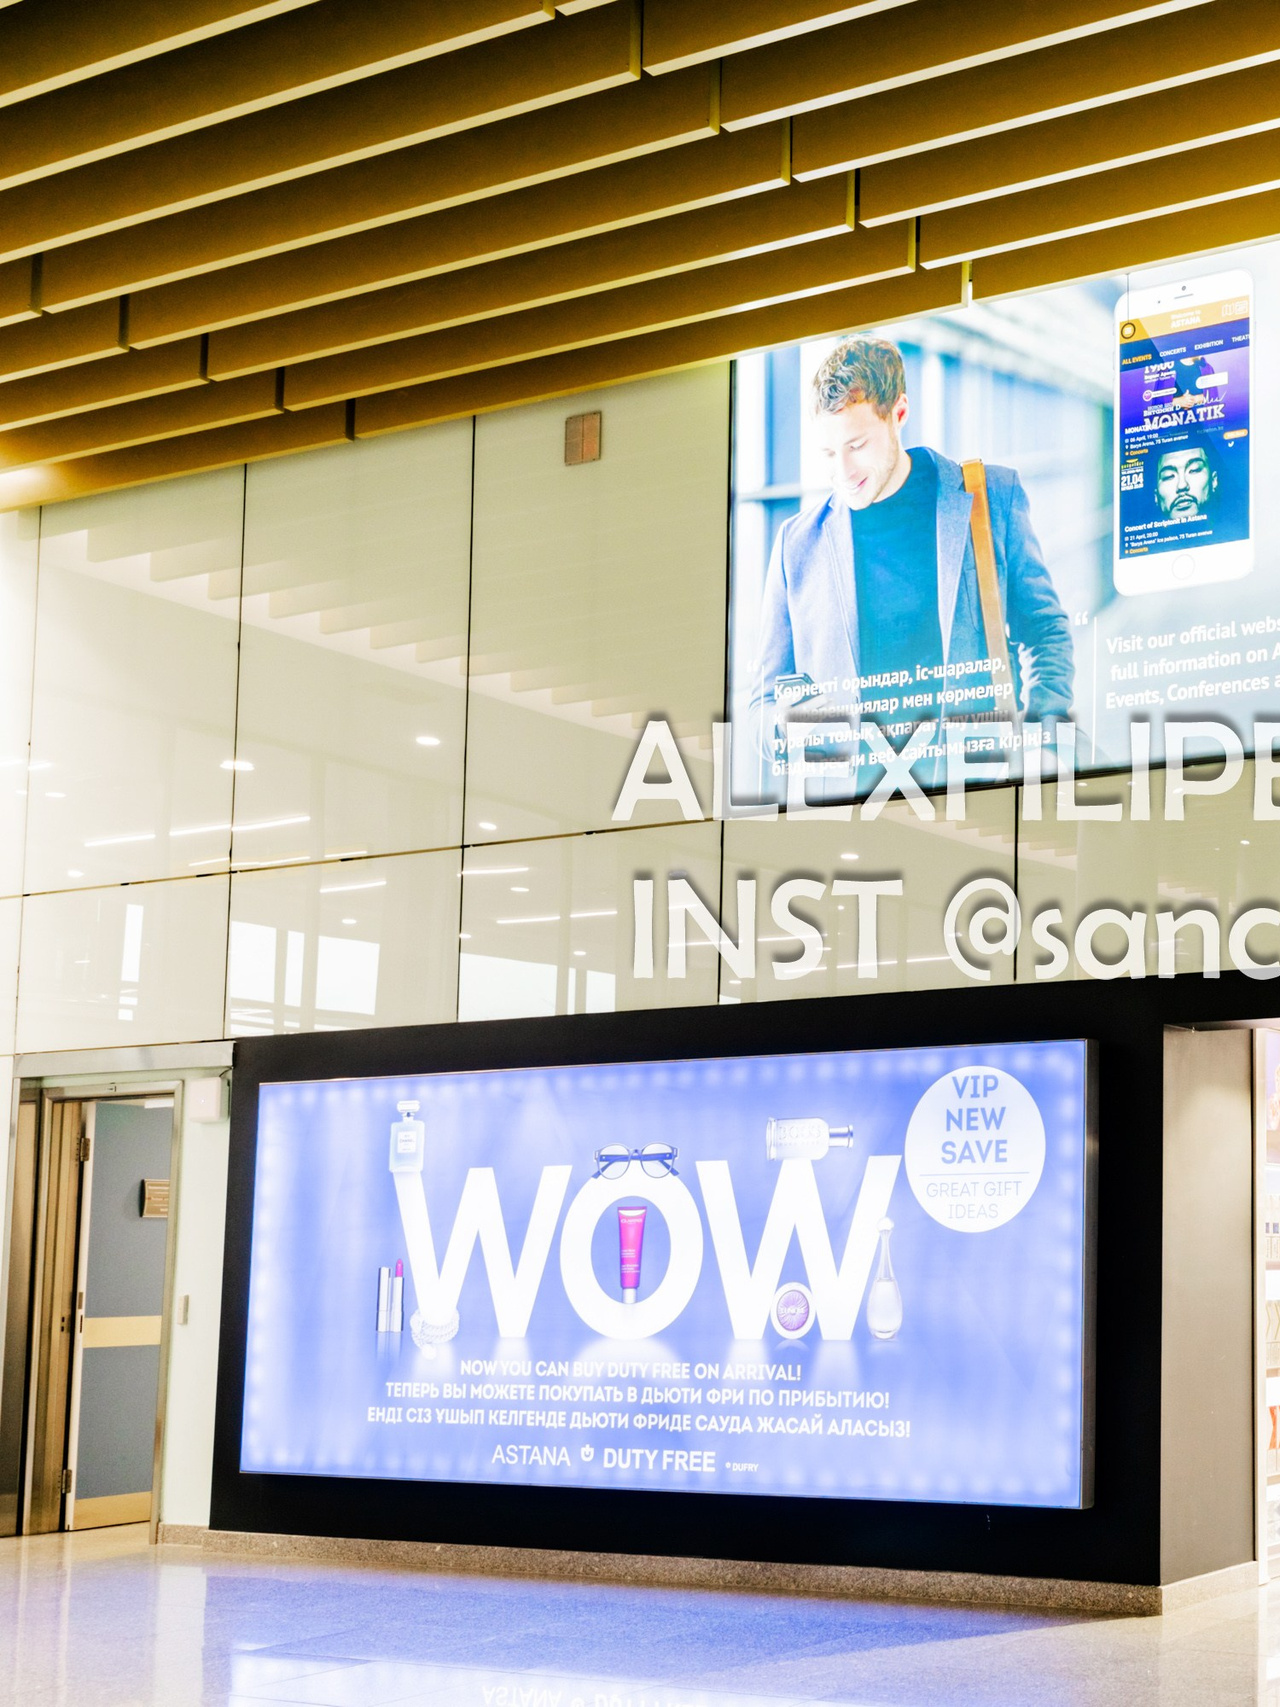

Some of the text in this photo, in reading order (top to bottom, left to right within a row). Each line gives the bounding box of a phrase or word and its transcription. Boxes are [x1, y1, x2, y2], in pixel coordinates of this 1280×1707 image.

[1132, 353, 1152, 363] EVENTS
[1159, 346, 1187, 357] CONCERTS
[1194, 339, 1224, 350] EXHIBITION
[1143, 403, 1225, 431] MONATIK
[1121, 472, 1144, 487] 21.04
[1124, 524, 1147, 533] Concert
[1106, 635, 1143, 654] Visit
[1147, 633, 1175, 650] our
[1179, 621, 1237, 645] official
[841, 669, 913, 694] орындар,
[916, 657, 1006, 682] іс-шаралар,
[1110, 661, 1138, 681] full
[1143, 651, 1241, 678] information
[1246, 647, 1268, 664] on
[902, 692, 933, 709] мен
[936, 682, 1013, 705] көрмелер
[1105, 688, 1164, 709] Events,
[1167, 673, 1269, 703] Conferences
[952, 1074, 999, 1099] VIP
[946, 1106, 1006, 1132] NEW
[941, 1139, 1008, 1164] SAVE
[926, 1180, 1022, 1198] GREAT GIFT
[948, 1203, 999, 1219] IDEAS
[392, 1154, 903, 1340] WOW
[460, 1359, 801, 1381] NOW YOU CAN BUY DUTY FREE ON ARRIVAL!
[385, 1381, 890, 1409] ТЕПЕРЬ ВЫ МОЖЕТЕ ПОКУПАТЬ В ДЬЮТИ ФРИ ПО ПРИБЫТИЮ!
[367, 1406, 403, 1424] ЕНДІ
[406, 1407, 432, 1424] СІЗ
[489, 1410, 566, 1429] КЕЛГЕНДЕ
[569, 1412, 629, 1430] ДЬЮТИ
[633, 1414, 691, 1432] ФРИДЕ
[695, 1415, 753, 1435] САУДА
[756, 1413, 823, 1435] ЖАСАЙ
[827, 1418, 911, 1438] АЛАСЫЗ!
[491, 1444, 759, 1472] ASTANA DUTY FREE DUFRY
